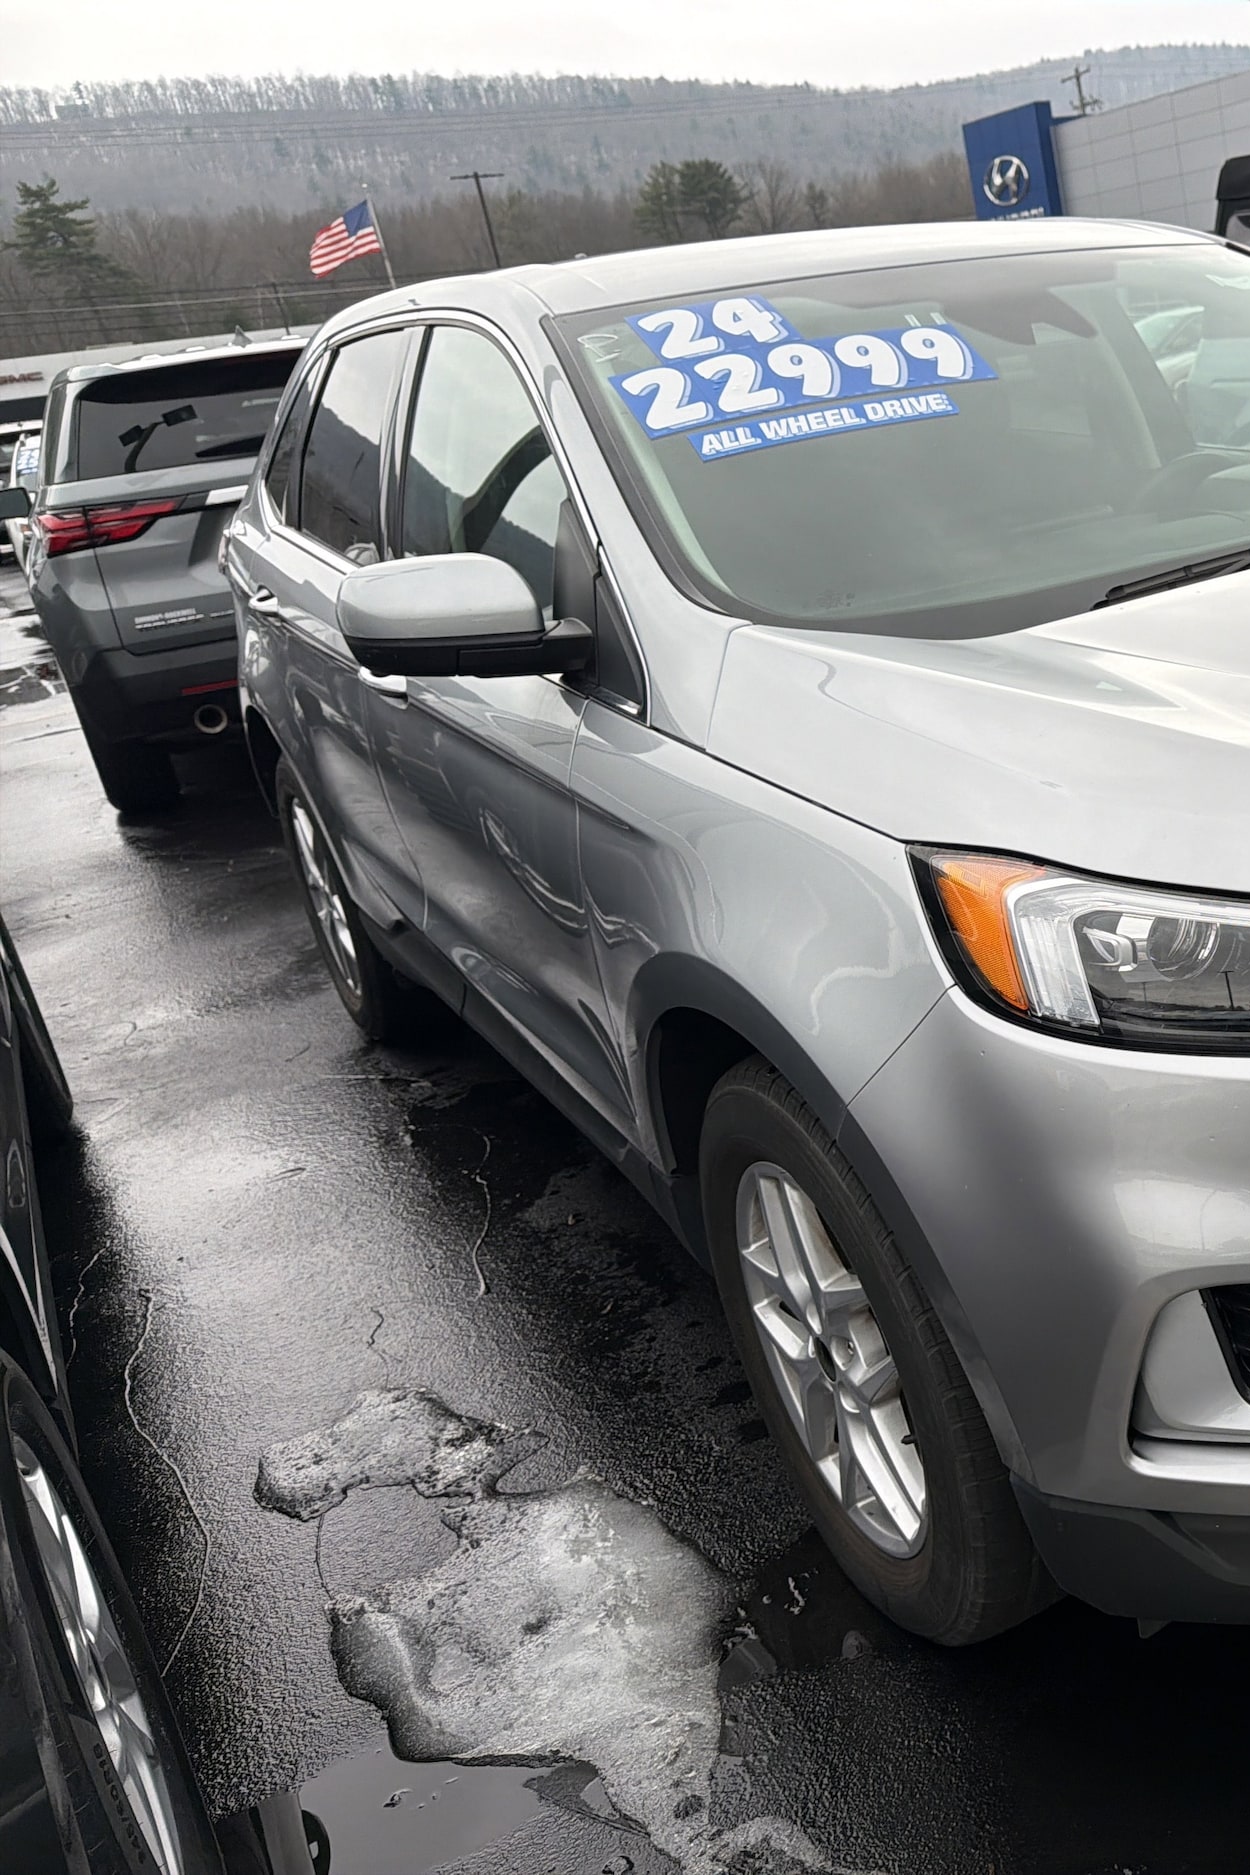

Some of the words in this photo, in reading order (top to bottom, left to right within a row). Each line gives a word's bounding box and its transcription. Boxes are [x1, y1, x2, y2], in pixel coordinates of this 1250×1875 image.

[637, 297, 788, 360] 24
[621, 328, 974, 431] 22999
[701, 426, 762, 456] ALL
[759, 407, 866, 441] WHEEL
[863, 393, 952, 422] DRIVE
